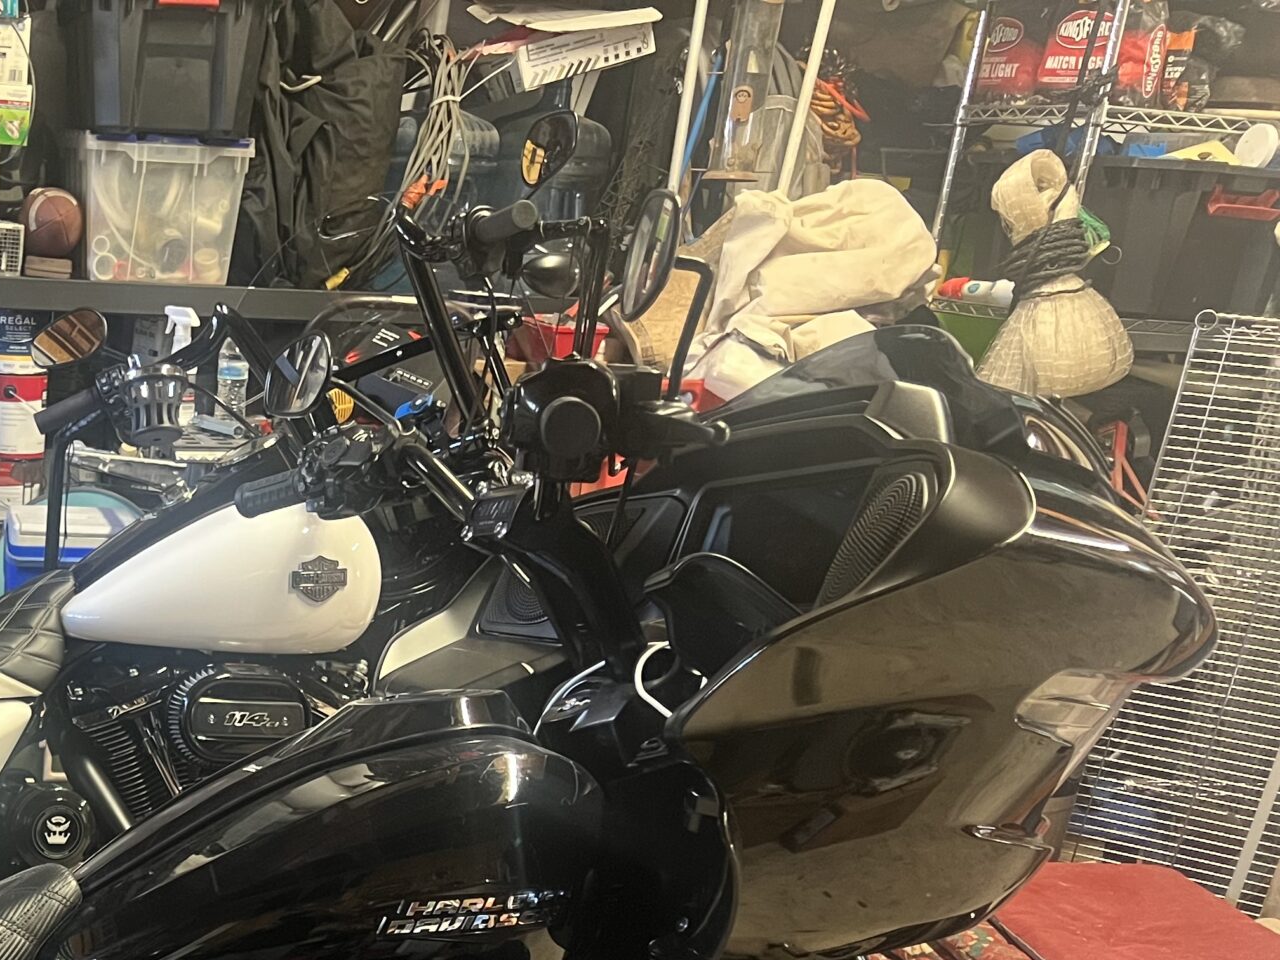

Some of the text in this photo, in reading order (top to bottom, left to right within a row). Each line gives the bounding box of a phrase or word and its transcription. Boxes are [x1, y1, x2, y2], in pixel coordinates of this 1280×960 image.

[1045, 56, 1076, 69] MATCH
[0, 316, 37, 325] REGAL
[224, 711, 270, 727] 114
